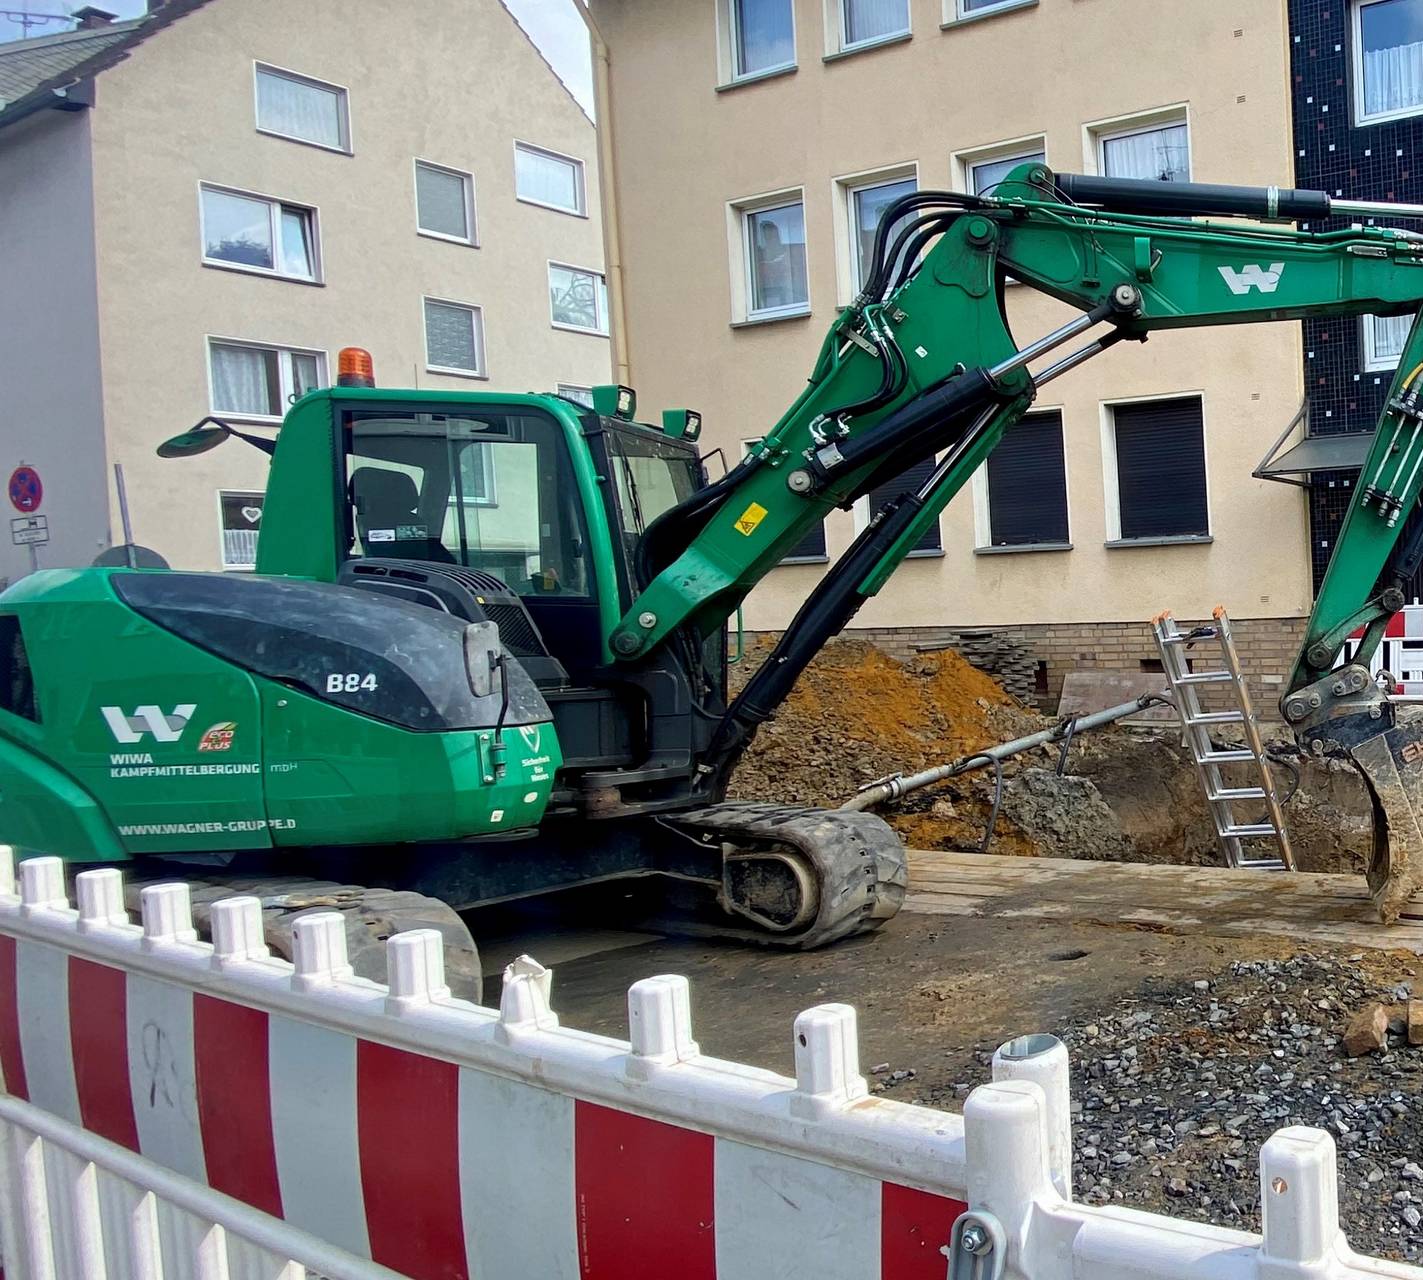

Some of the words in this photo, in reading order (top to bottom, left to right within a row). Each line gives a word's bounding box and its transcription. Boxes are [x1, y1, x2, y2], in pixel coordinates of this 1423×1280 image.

[327, 673, 379, 693] B84
[199, 741, 232, 750] PLUS
[110, 753, 153, 765] WIWA
[110, 764, 260, 778] KAMPFMITTELBERGUNG
